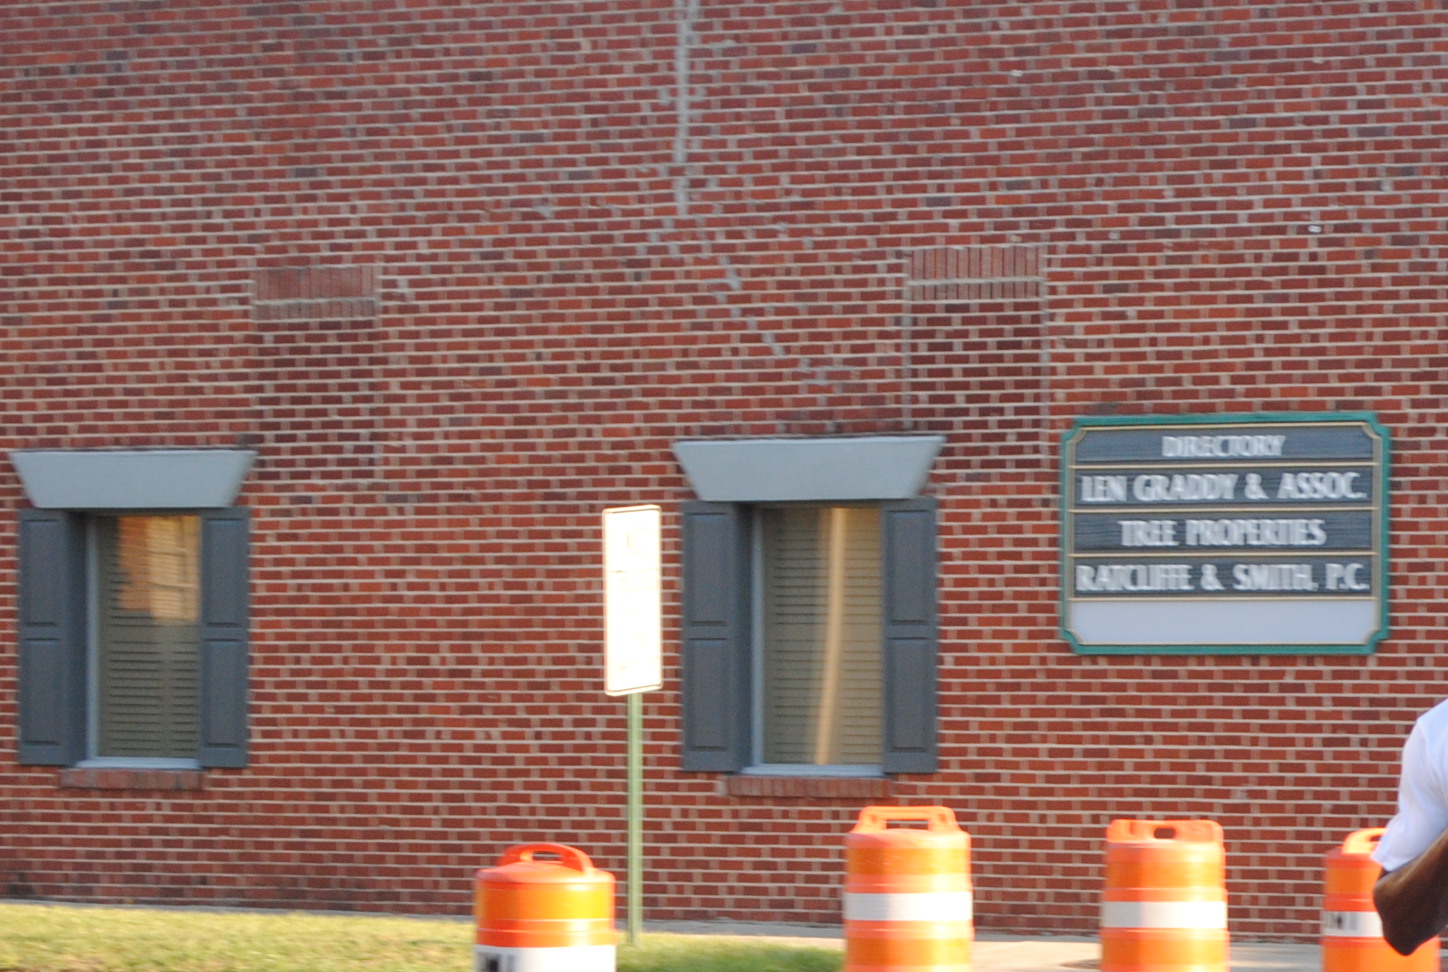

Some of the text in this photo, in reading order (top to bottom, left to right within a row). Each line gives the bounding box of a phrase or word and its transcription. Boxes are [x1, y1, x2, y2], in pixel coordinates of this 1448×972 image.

[1161, 435, 1287, 458] DIRECTORY
[1132, 473, 1239, 501] GRADDY
[1244, 472, 1270, 500] &
[1277, 471, 1368, 499] ASSOC.
[1117, 518, 1328, 547] TREE PROPERTIES
[1075, 563, 1196, 591] RATCLIFFE
[1200, 563, 1227, 591] &
